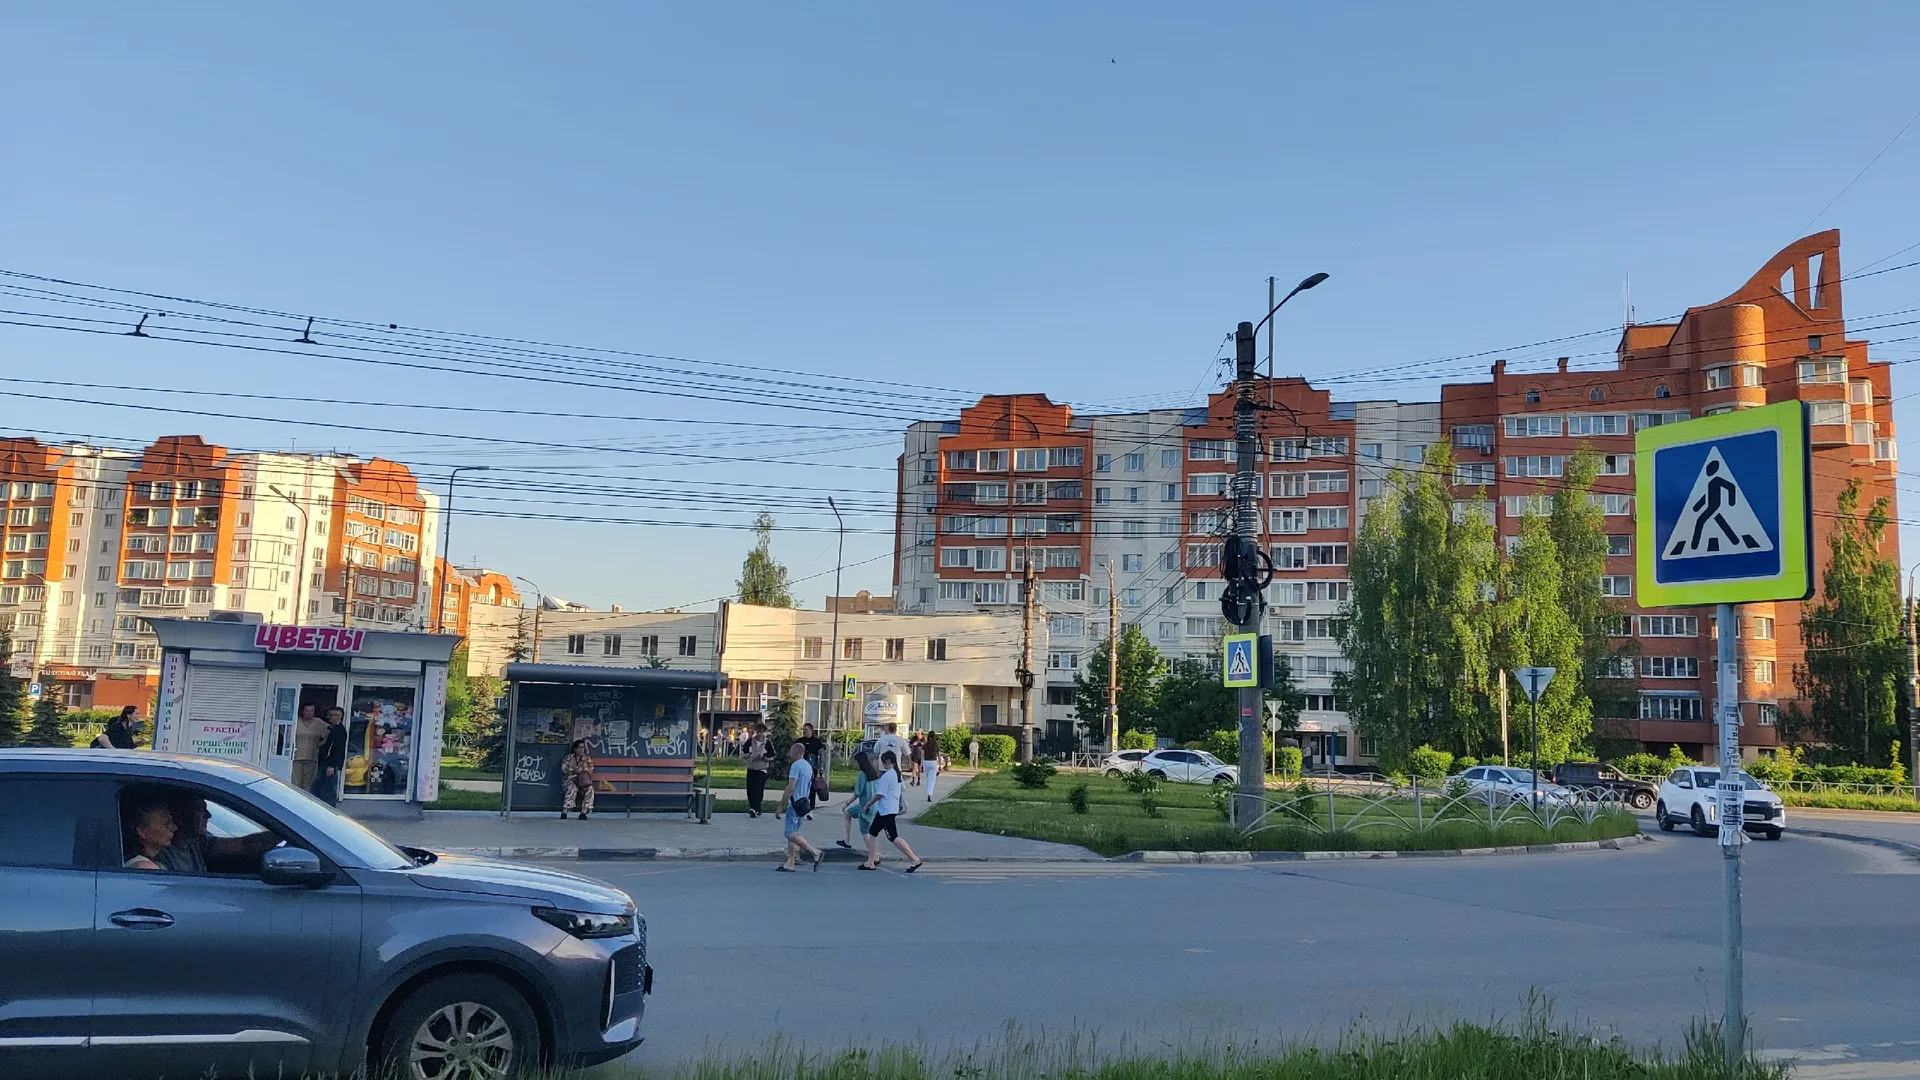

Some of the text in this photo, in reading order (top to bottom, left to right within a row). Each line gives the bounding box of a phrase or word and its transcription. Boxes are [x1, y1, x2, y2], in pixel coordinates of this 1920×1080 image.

[255, 624, 365, 653] ЦВЕТЫ
[167, 656, 178, 694] ЦВЕТЫ
[435, 670, 444, 706] ЦВЕТЫ
[163, 701, 174, 731] ШАРЫ
[203, 726, 240, 734] БУКЕТЫ
[432, 712, 440, 740] ШАРЫ
[192, 740, 249, 748] ГОРШЕЧНЫЕ
